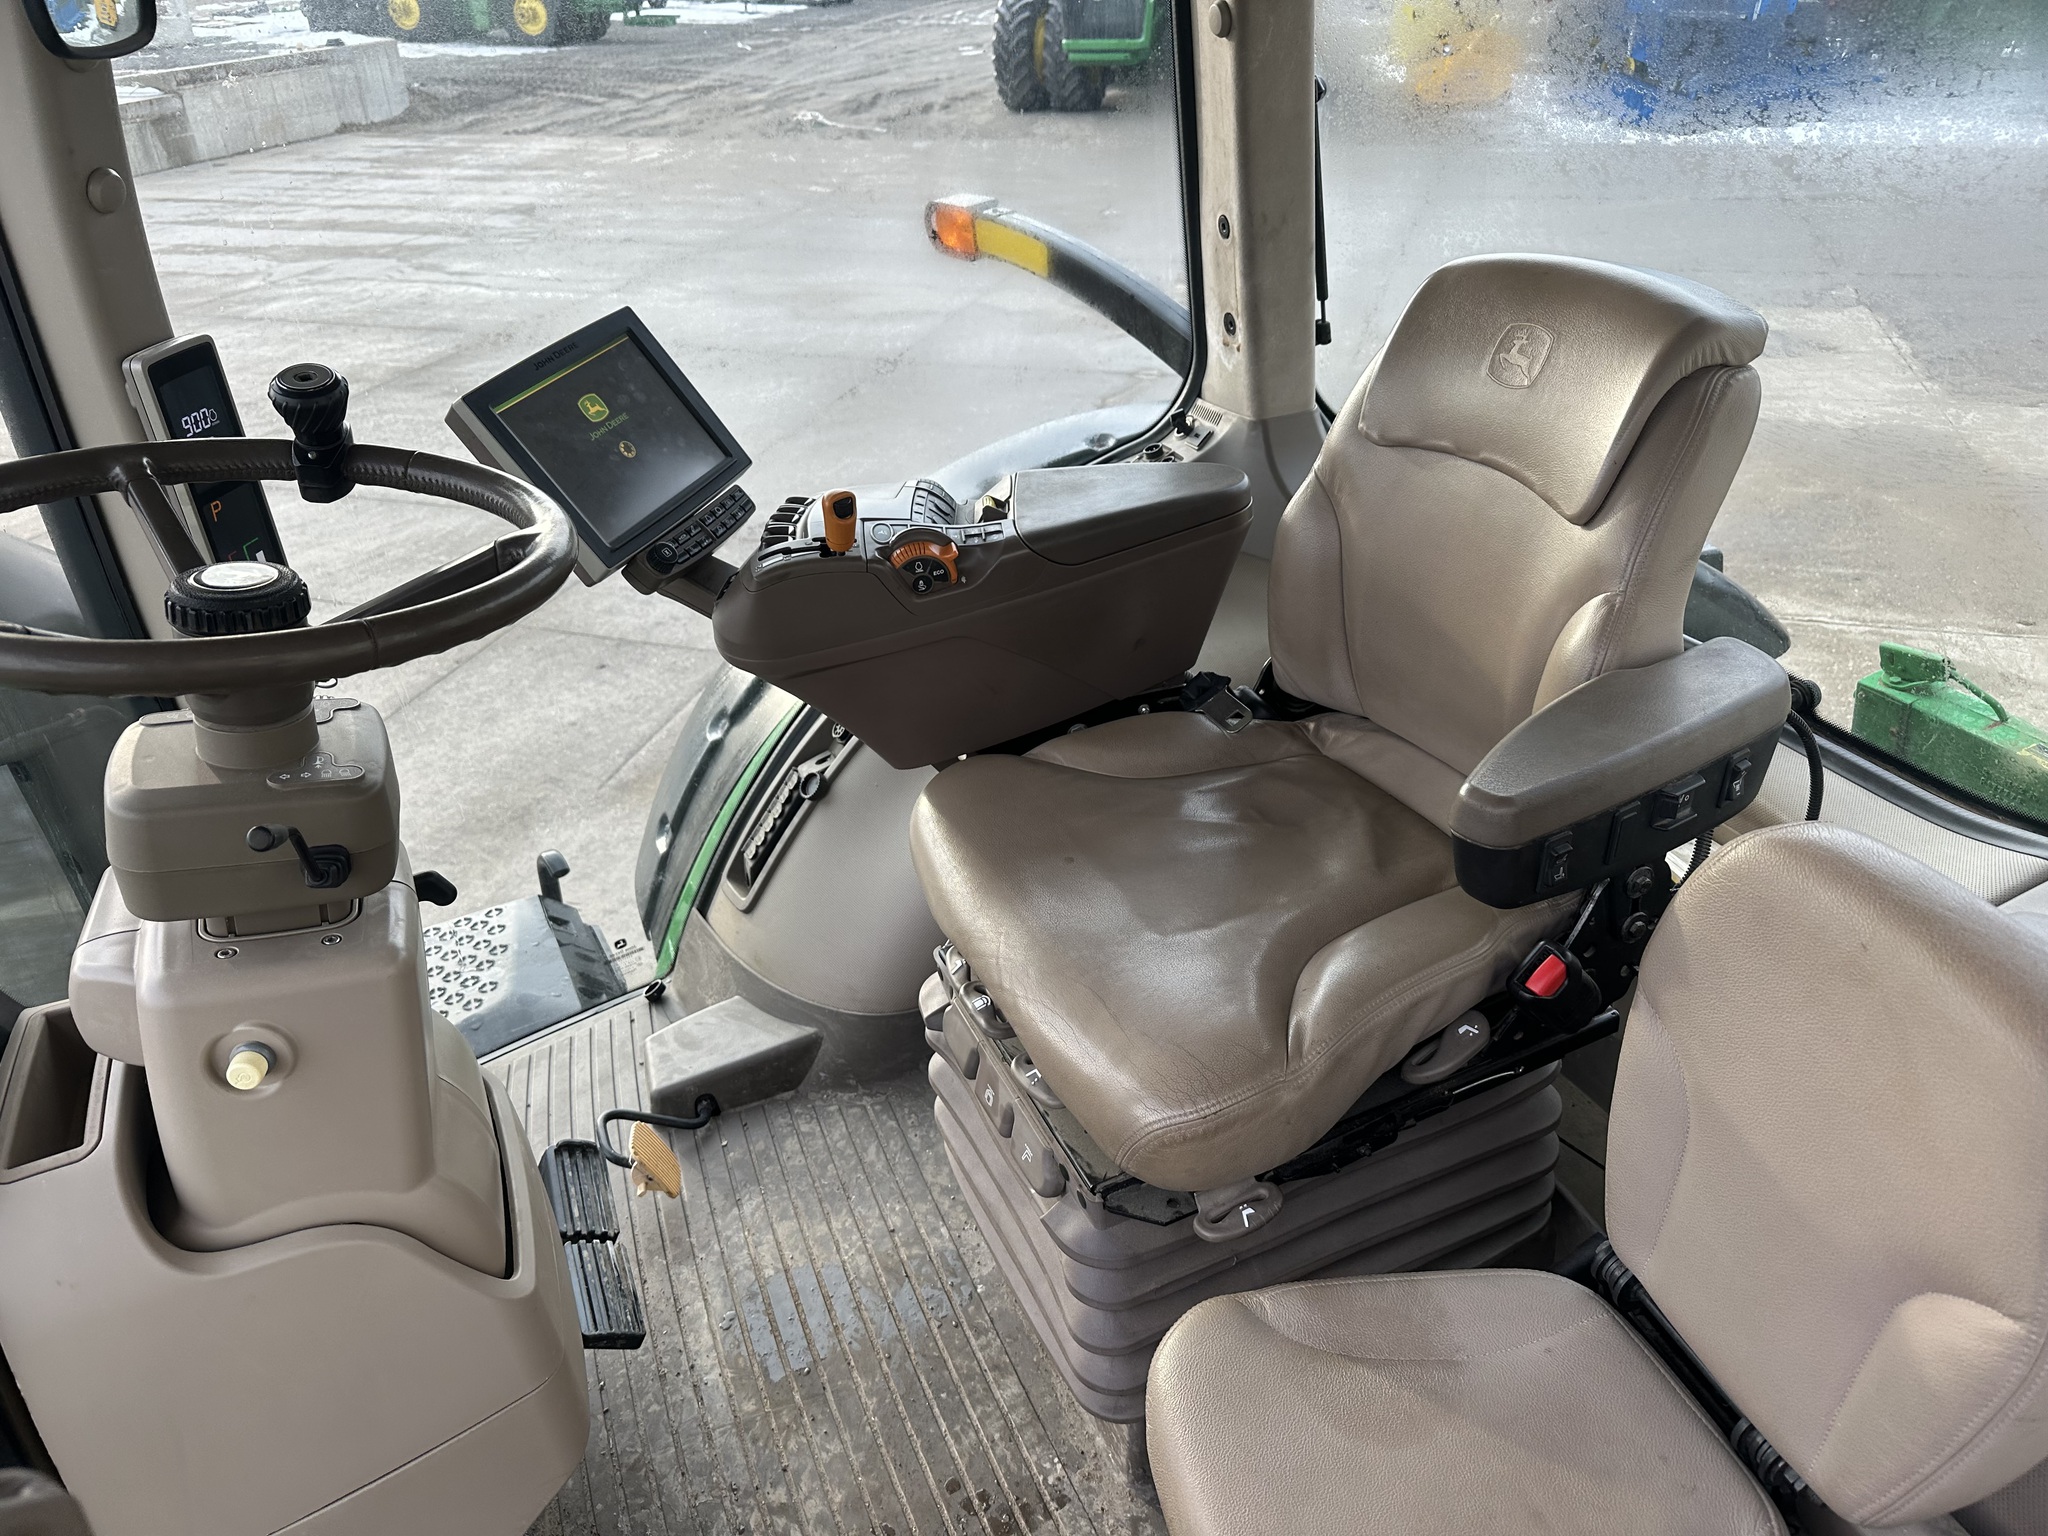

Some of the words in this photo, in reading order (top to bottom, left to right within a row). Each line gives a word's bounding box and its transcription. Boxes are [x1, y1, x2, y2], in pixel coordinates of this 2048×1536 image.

[533, 356, 554, 370] JOHN
[554, 343, 578, 359] DEERE
[181, 408, 211, 437] 900
[589, 426, 608, 440] JOHN
[606, 413, 629, 429] DEERE
[210, 500, 222, 522] P
